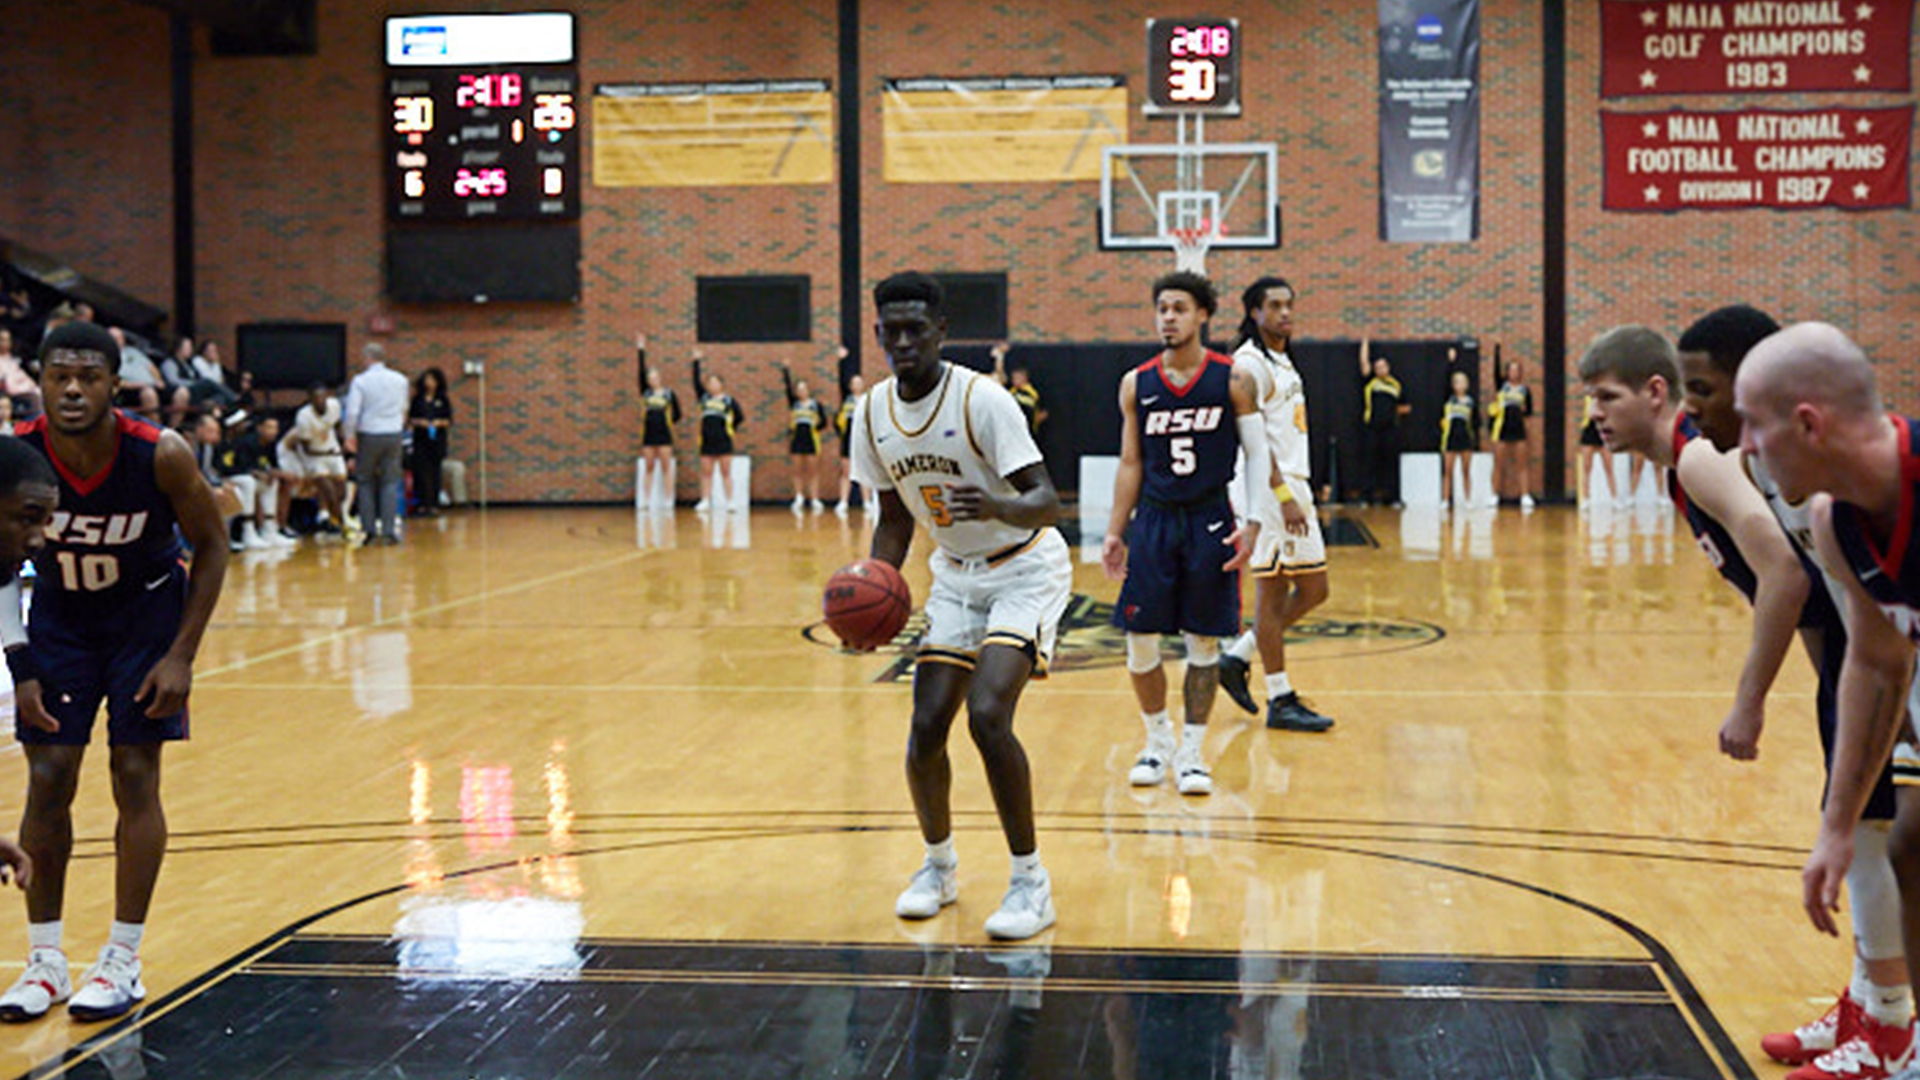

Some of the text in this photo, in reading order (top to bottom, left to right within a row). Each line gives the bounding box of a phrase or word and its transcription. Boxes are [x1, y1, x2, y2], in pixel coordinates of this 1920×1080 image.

[1667, 0, 1845, 28] NAIA NATIONAL
[1171, 26, 1230, 56] 2:08
[1644, 30, 1866, 58] GOLF CHAMPIONS
[1169, 60, 1215, 100] 30
[1727, 61, 1788, 87] 1983
[394, 97, 434, 132] 30
[533, 95, 576, 130] 26
[1667, 114, 1845, 141] NAIA NATIONAL
[1627, 145, 1886, 173] FOOTBALL CHAMPIONS
[404, 170, 424, 197] 6
[1679, 180, 1751, 201] DIVISION
[1777, 177, 1833, 202] 1987
[1144, 406, 1224, 436] RSU
[890, 454, 963, 482] CAMERON
[1170, 437, 1196, 476] 5
[919, 485, 955, 527] 5
[56, 551, 120, 592] 10
